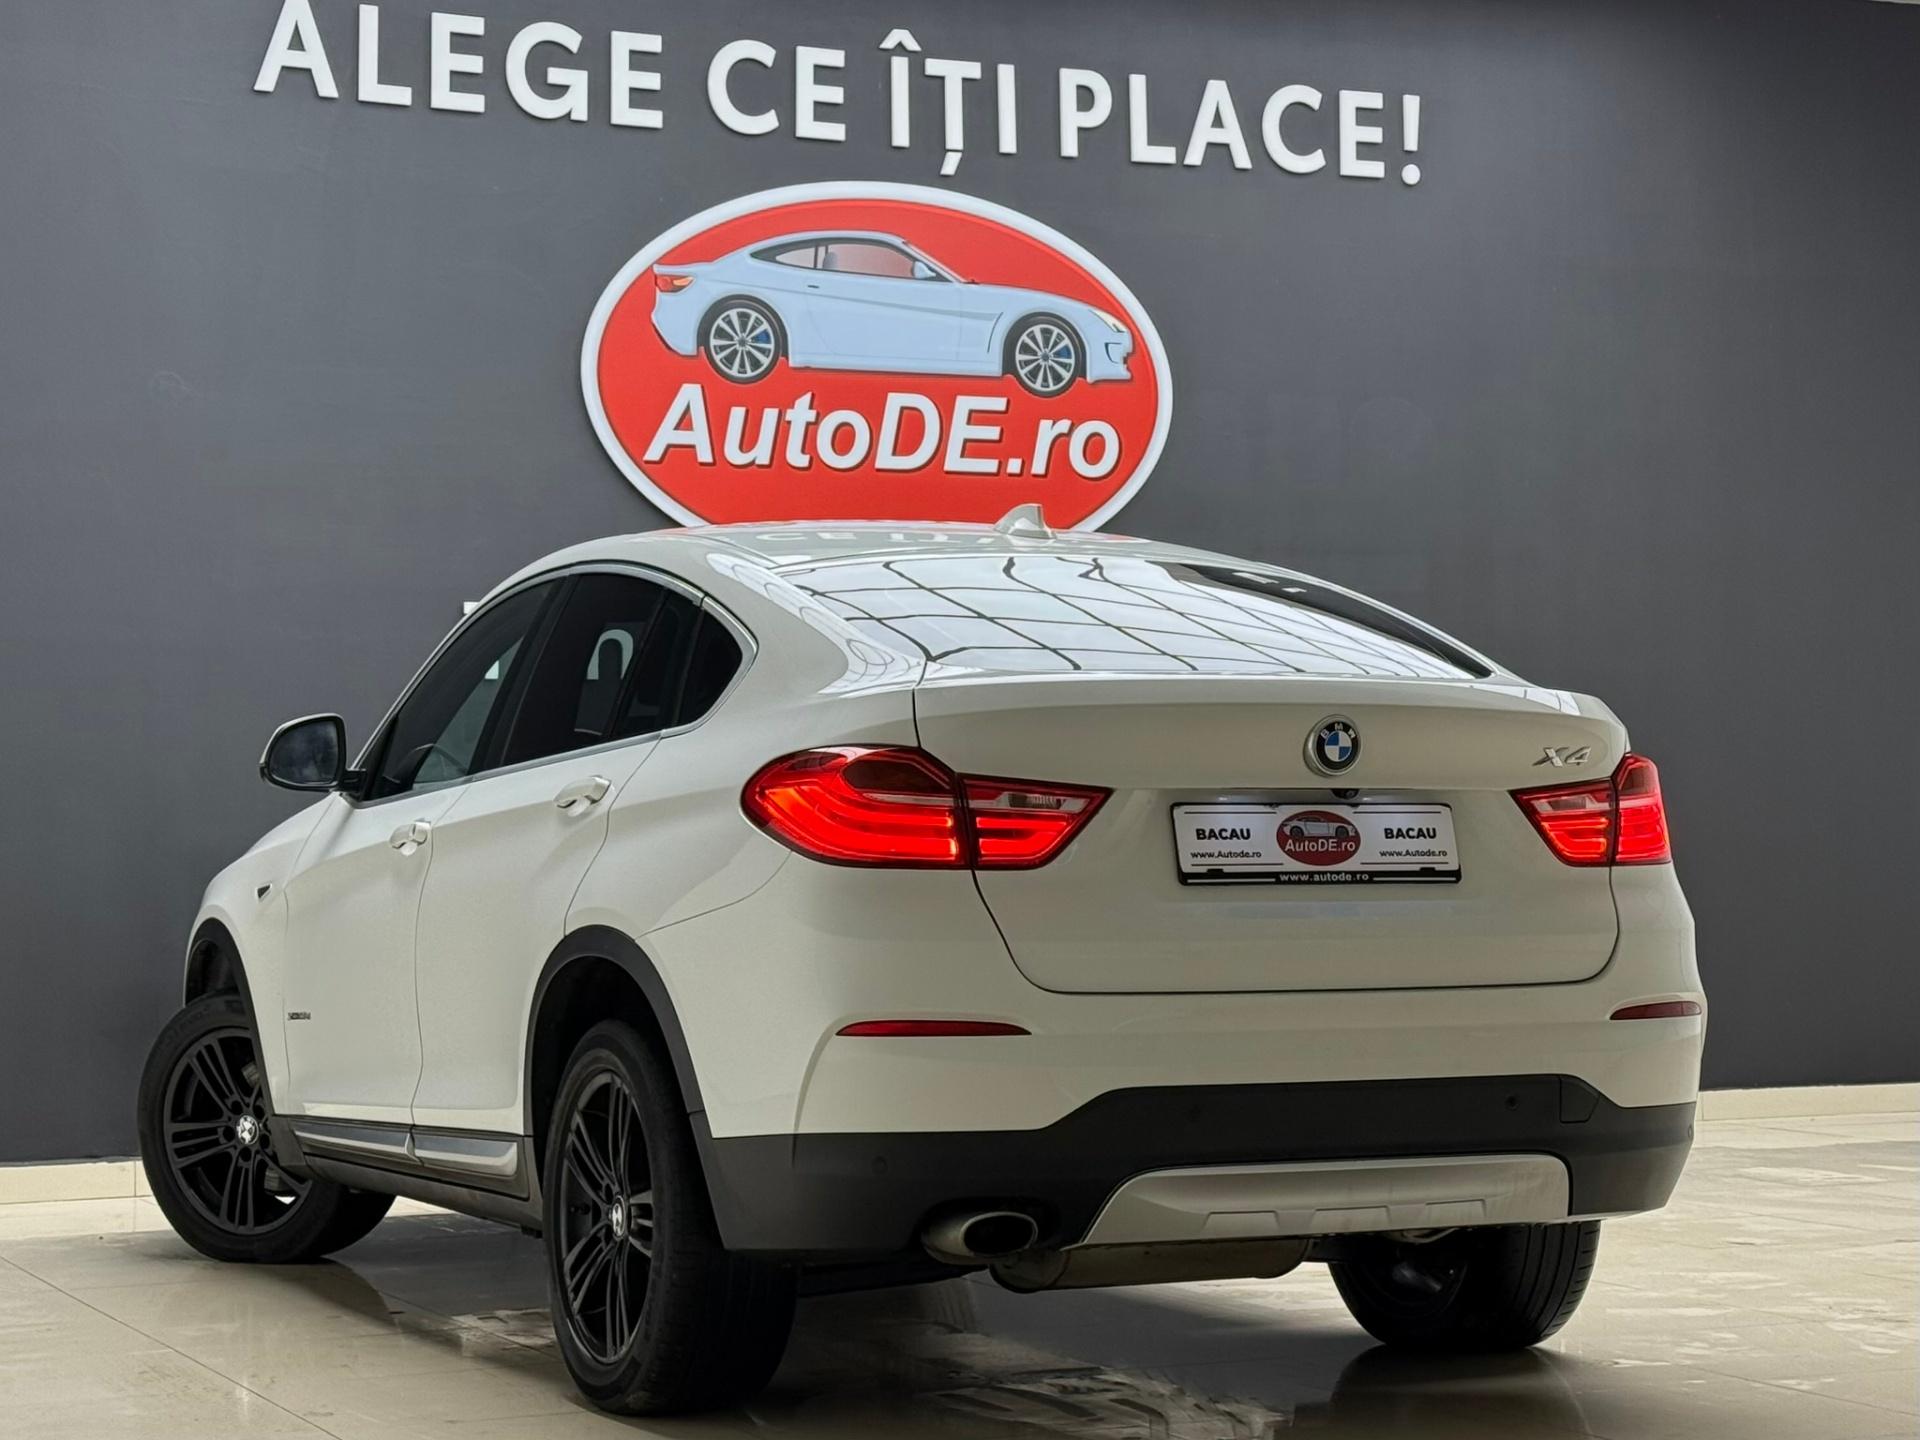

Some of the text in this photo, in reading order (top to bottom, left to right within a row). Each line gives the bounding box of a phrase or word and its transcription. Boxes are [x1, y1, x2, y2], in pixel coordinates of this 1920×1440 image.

[253, 0, 1422, 186] ALEGE CE ÎȚI PLACE!
[641, 382, 1123, 480] AutoDE.ro
[1320, 722, 1356, 740] BMW
[1532, 746, 1592, 768] X4
[1195, 828, 1251, 841] BACAU
[1384, 827, 1438, 840] BACAU
[1284, 838, 1356, 852] AutoDE.ro
[1190, 850, 1262, 859] www.Autode.ro
[1279, 871, 1369, 882] www.autode.ro
